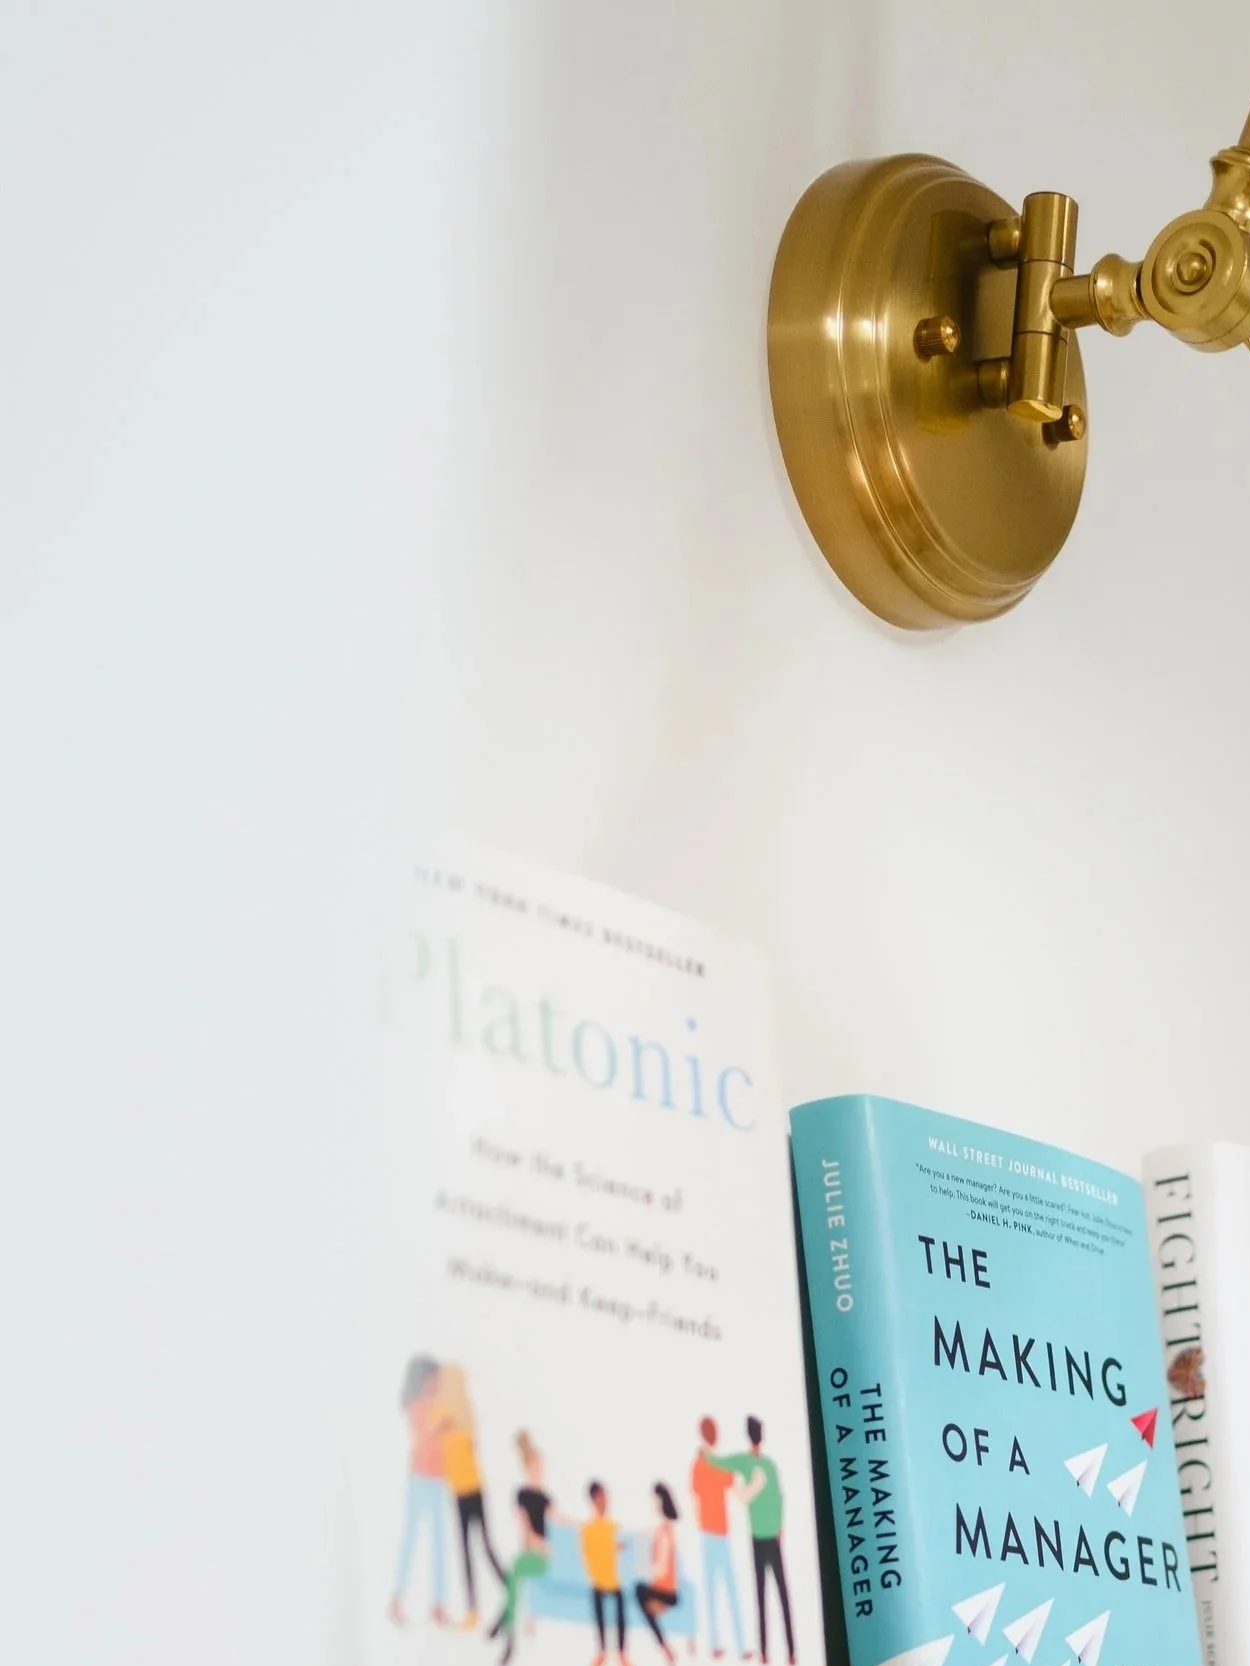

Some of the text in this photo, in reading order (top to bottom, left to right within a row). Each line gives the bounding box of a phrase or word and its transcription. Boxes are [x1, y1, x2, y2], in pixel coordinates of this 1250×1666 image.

[374, 928, 757, 1133] Platonic
[928, 1136, 1119, 1206] WALL STREET JOURNAL BESTSELLER
[930, 1184, 938, 1193] to
[939, 1185, 955, 1198] help.
[956, 1190, 969, 1201] This
[970, 1194, 987, 1206] book
[988, 1199, 999, 1209] will
[1000, 1204, 1011, 1214] get
[1012, 1207, 1023, 1217] you
[1025, 1210, 1033, 1218] on
[1033, 1211, 1044, 1222] the
[932, 1170, 944, 1180] you
[951, 1175, 965, 1185] new
[966, 1179, 997, 1193] manager?
[999, 1185, 1010, 1196] Are
[1012, 1192, 1023, 1201] you
[821, 1159, 854, 1312] JULIE ZHUO
[918, 1234, 991, 1289] THE
[1002, 1219, 1012, 1229] H.
[1036, 1229, 1055, 1240] author
[933, 1315, 1127, 1407] MAKING
[1155, 1174, 1219, 1582] FIGHT RIGHT
[830, 1367, 874, 1620] OF A MANAGER
[859, 1382, 902, 1590] THE MAKING
[941, 1423, 1031, 1475] OF A
[955, 1502, 1182, 1593] MANAGER
